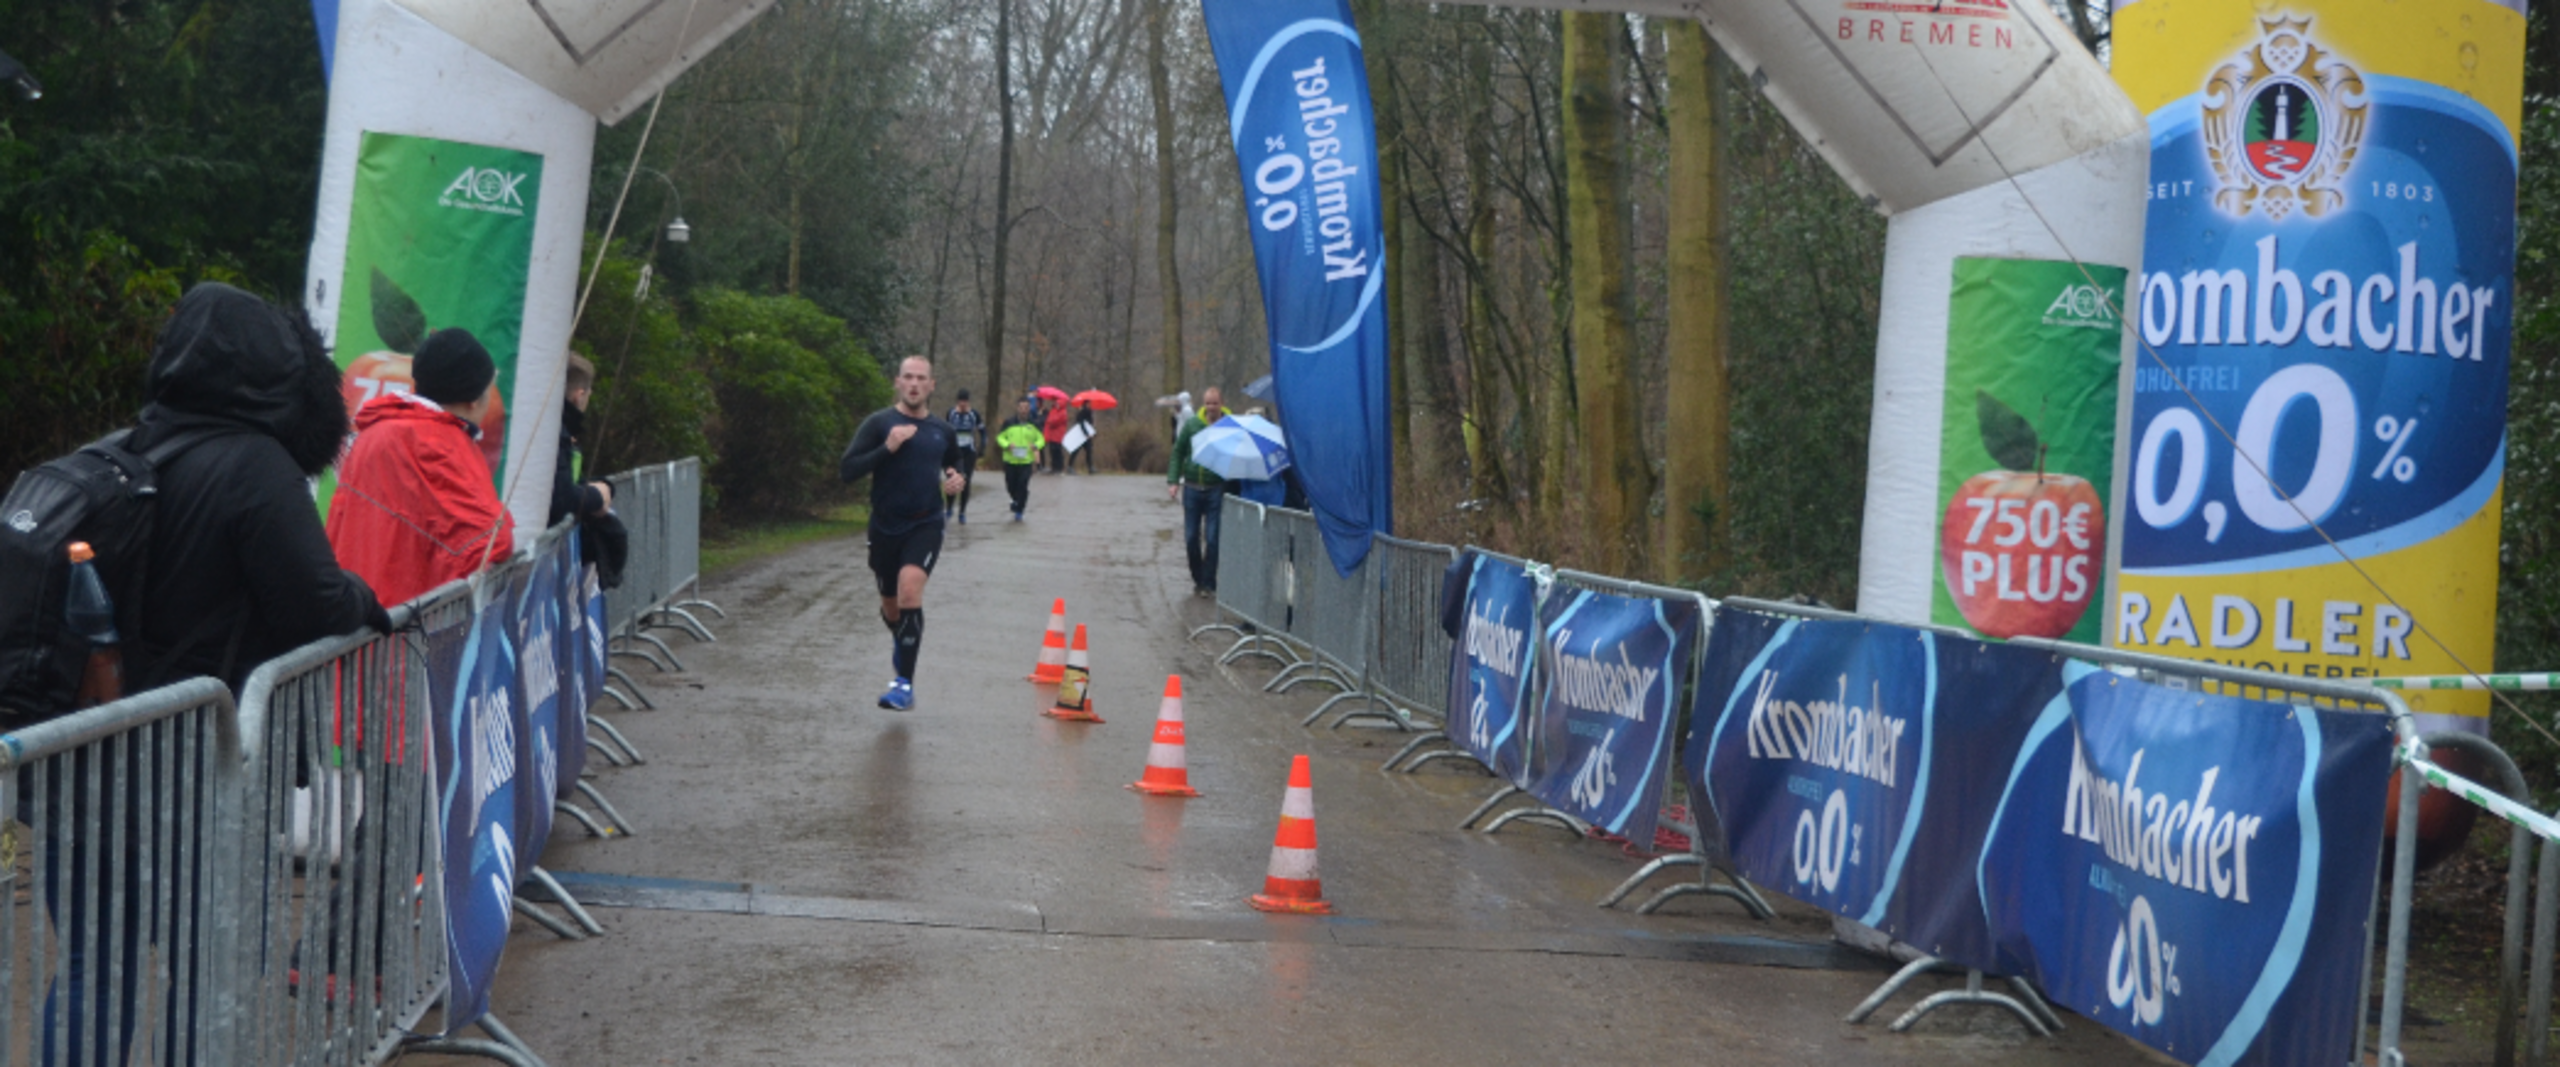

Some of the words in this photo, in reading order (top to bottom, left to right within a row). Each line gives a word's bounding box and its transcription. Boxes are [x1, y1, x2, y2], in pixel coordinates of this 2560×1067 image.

[1837, 17, 2012, 49] BREMEN
[443, 165, 527, 207] AOK
[2371, 180, 2433, 202] 1803
[2044, 283, 2114, 320] AOK
[2138, 233, 2494, 361] ombacher
[2135, 364, 2240, 393] OHOLFREI
[1964, 496, 2091, 550] 750€
[1961, 550, 2089, 603] PLUS
[2118, 591, 2416, 661] RADLER
[2062, 722, 2262, 904] Kmbacher
